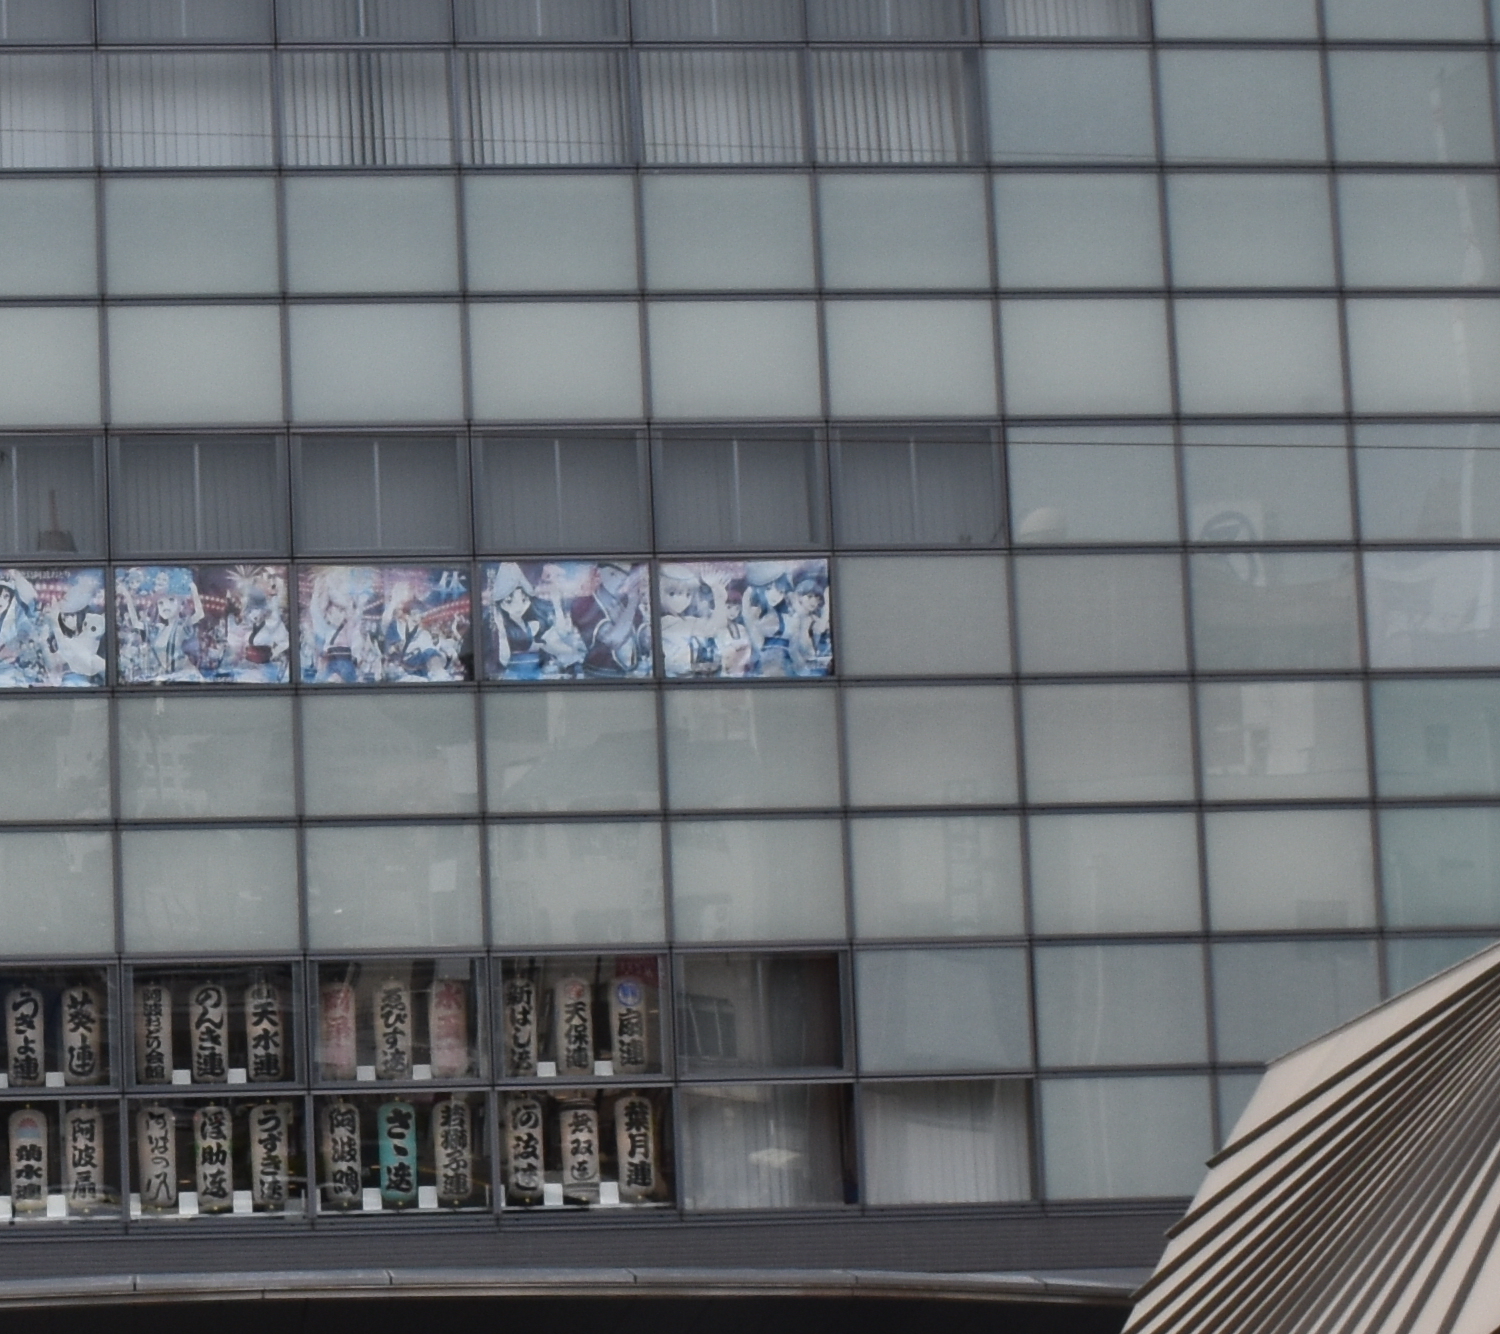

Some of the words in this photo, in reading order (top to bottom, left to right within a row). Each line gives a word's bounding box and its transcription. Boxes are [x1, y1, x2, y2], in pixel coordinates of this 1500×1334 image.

[194, 987, 226, 1078] のんき連
[624, 1100, 651, 1188] 葉月連
